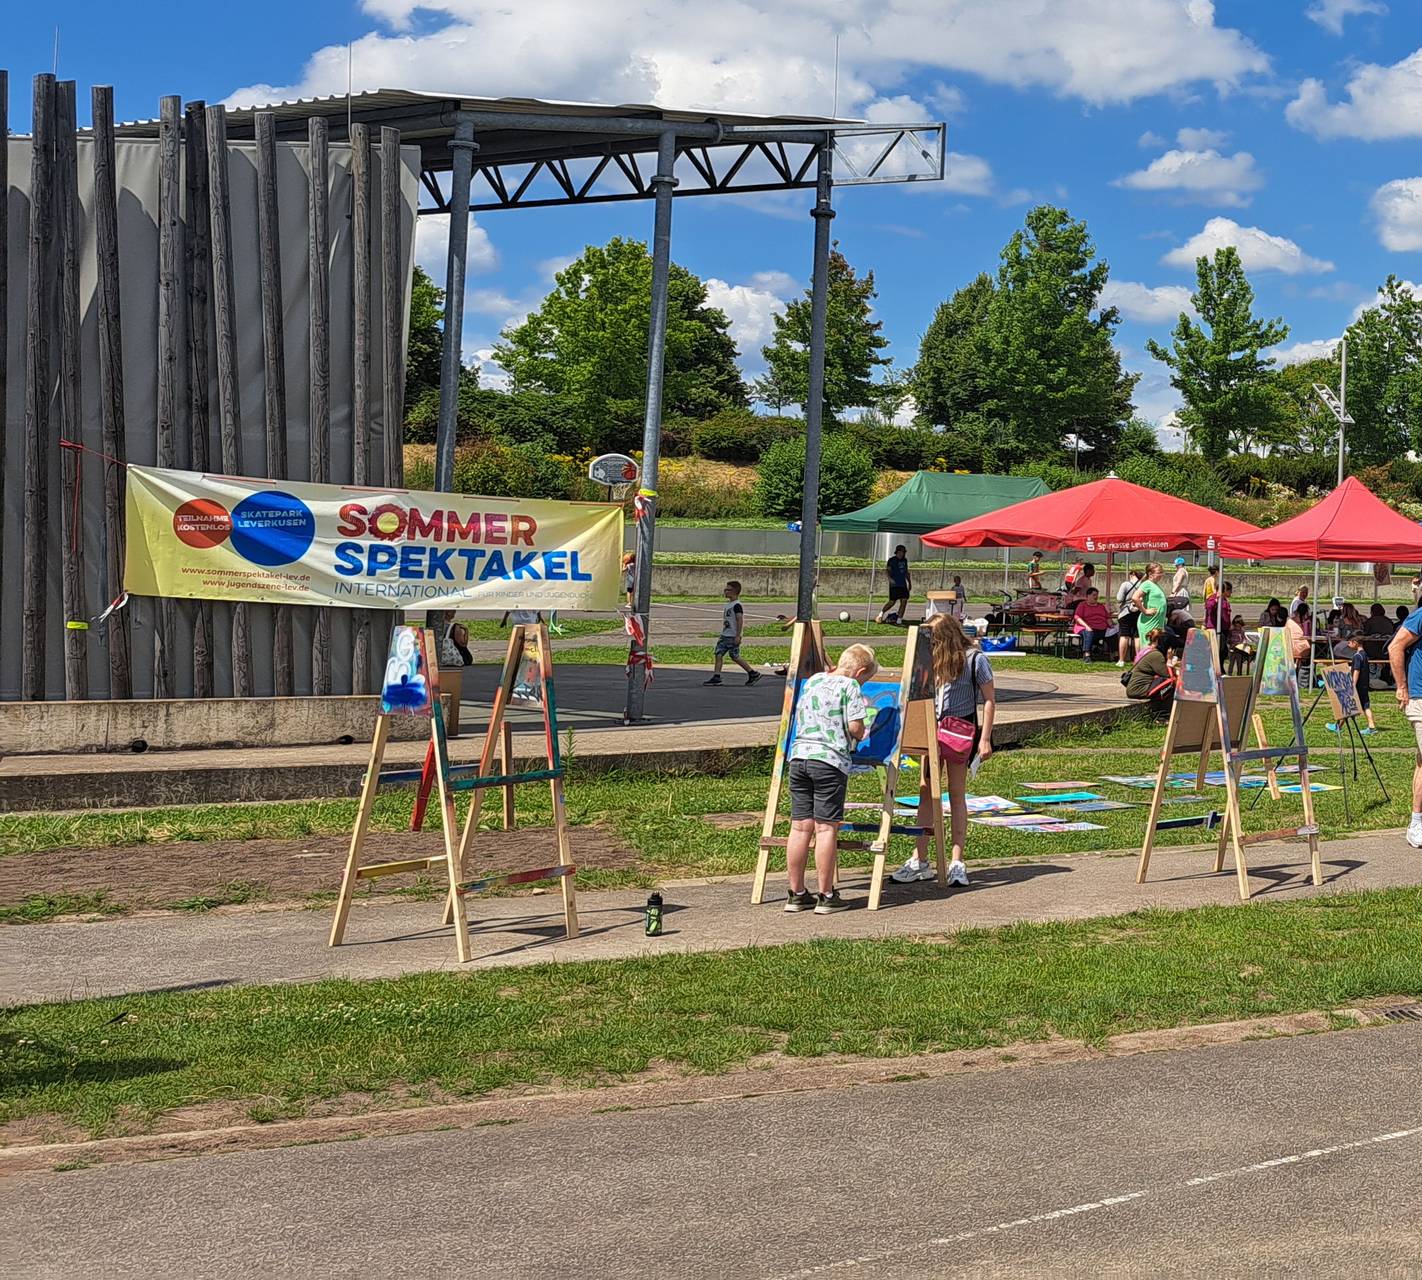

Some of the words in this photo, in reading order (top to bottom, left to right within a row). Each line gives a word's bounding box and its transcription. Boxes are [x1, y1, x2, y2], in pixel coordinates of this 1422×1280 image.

[241, 510, 303, 519] SKATEPARK
[177, 523, 231, 532] KOSTENLOS
[238, 519, 306, 528] LEVERKUSEN
[336, 503, 537, 546] SOMMER
[1131, 541, 1168, 549] Leverkusen
[334, 542, 593, 582] SPEKTAKEL
[181, 566, 311, 582] www.sommerspektakel-lev.de
[202, 579, 310, 592] www.jugendszene-lev.de
[334, 582, 472, 599] INTERNATIONAL
